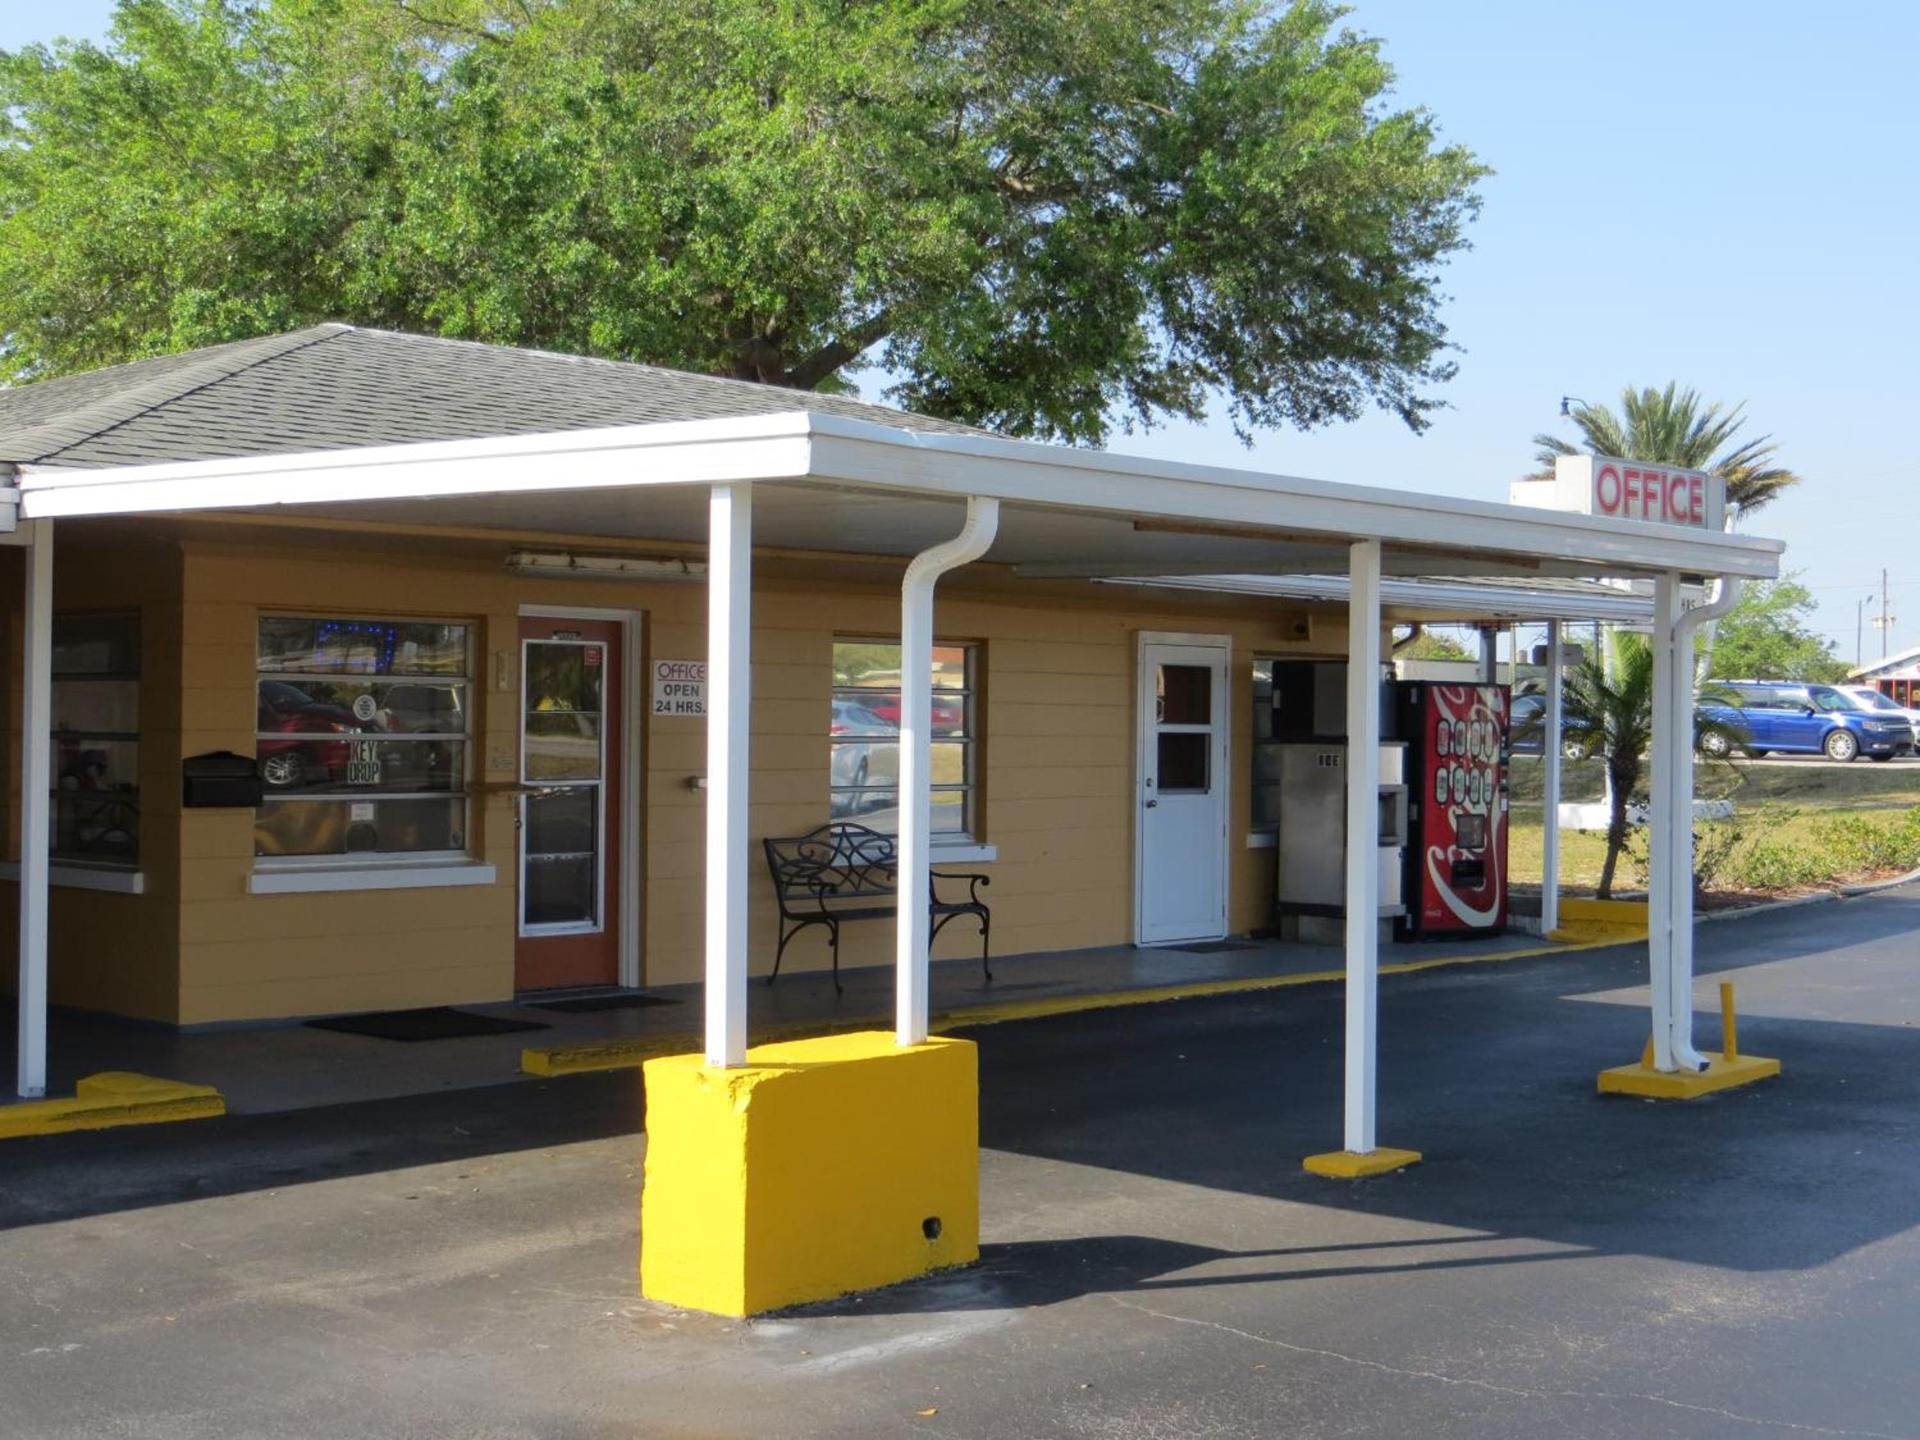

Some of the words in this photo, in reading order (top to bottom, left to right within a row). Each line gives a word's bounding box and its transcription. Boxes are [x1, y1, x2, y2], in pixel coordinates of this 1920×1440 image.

[1596, 463, 1703, 525] OFFICE
[657, 662, 705, 679] OFFICE
[663, 684, 700, 697] OPEN
[655, 699, 671, 712] 24
[675, 700, 706, 714] HRS.
[350, 740, 376, 762] KEY
[1319, 754, 1339, 767] ICE
[348, 761, 380, 782] DROP
